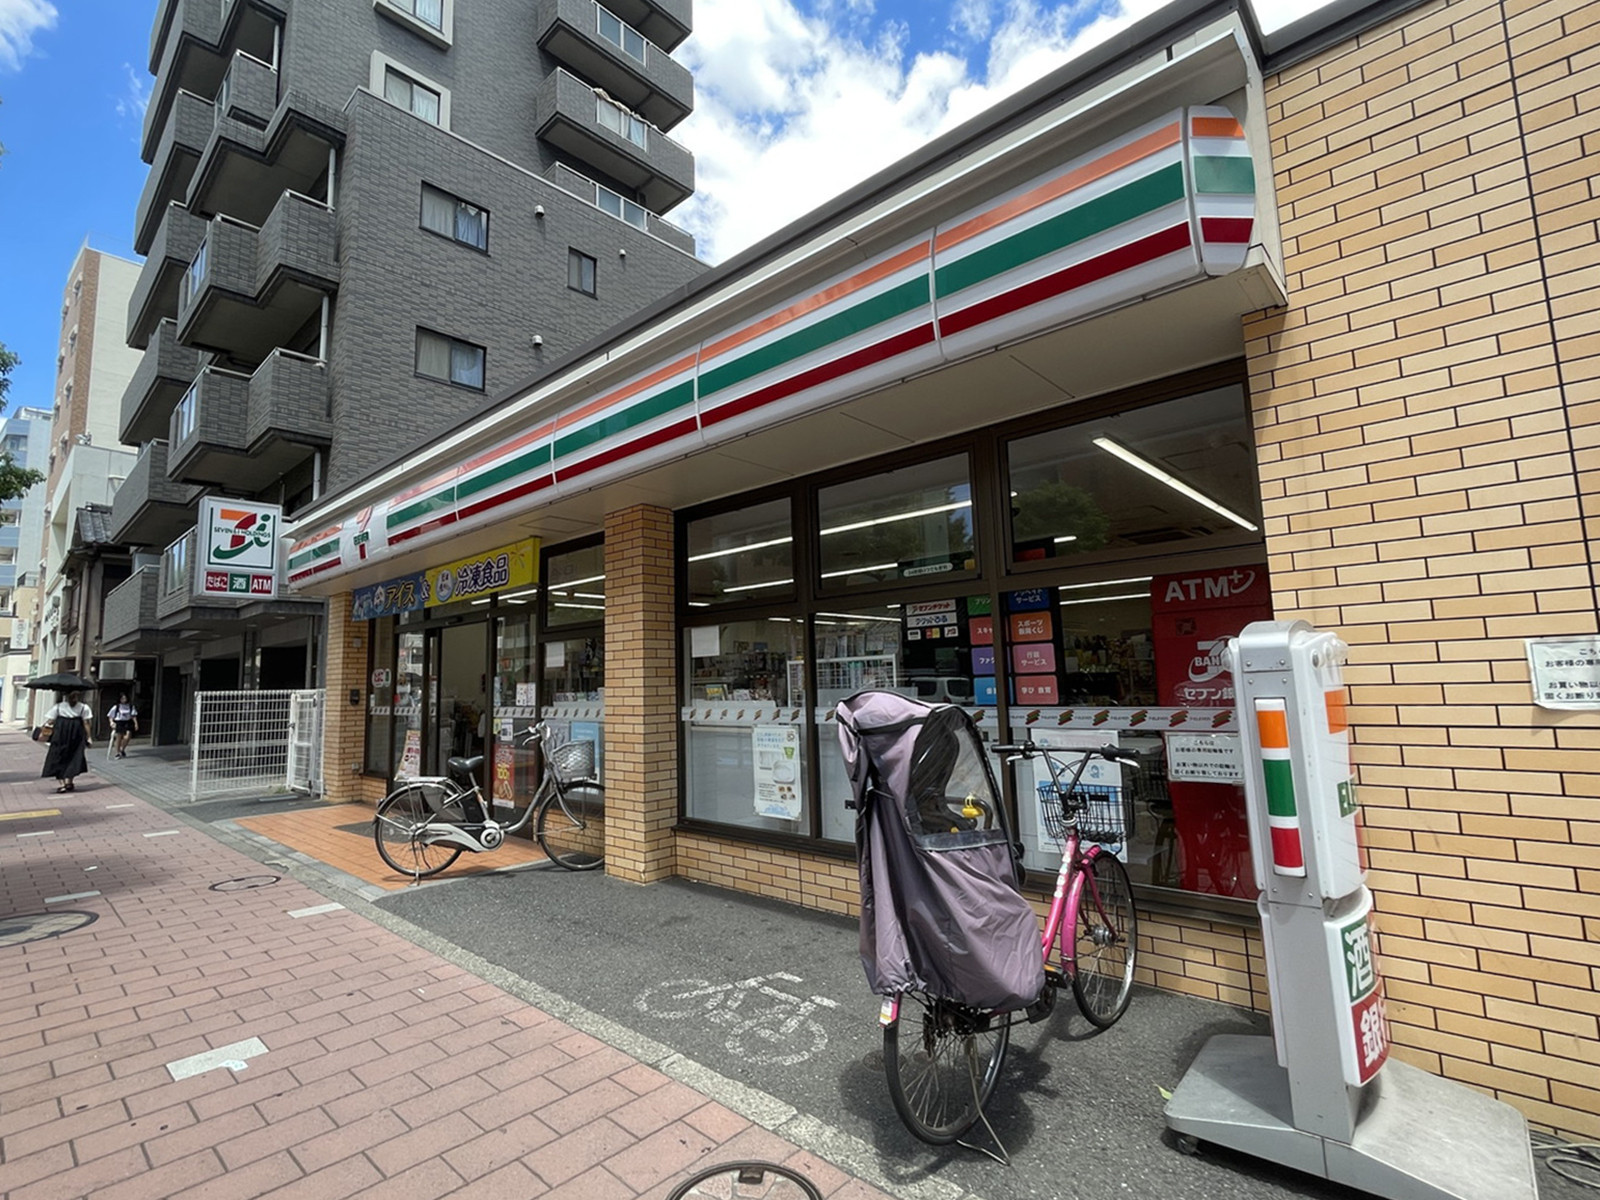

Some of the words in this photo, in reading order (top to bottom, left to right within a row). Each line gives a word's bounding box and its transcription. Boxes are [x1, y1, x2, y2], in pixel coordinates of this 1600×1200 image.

[206, 576, 227, 588] たばこ
[232, 577, 247, 590] 酒
[252, 578, 271, 591] ATM
[384, 581, 416, 611] アイス
[454, 553, 510, 596] 冷凍食品
[1016, 595, 1042, 605] サービス
[1017, 619, 1043, 628] スポーツ
[1020, 658, 1047, 667] サービス
[1345, 923, 1374, 997] 酒
